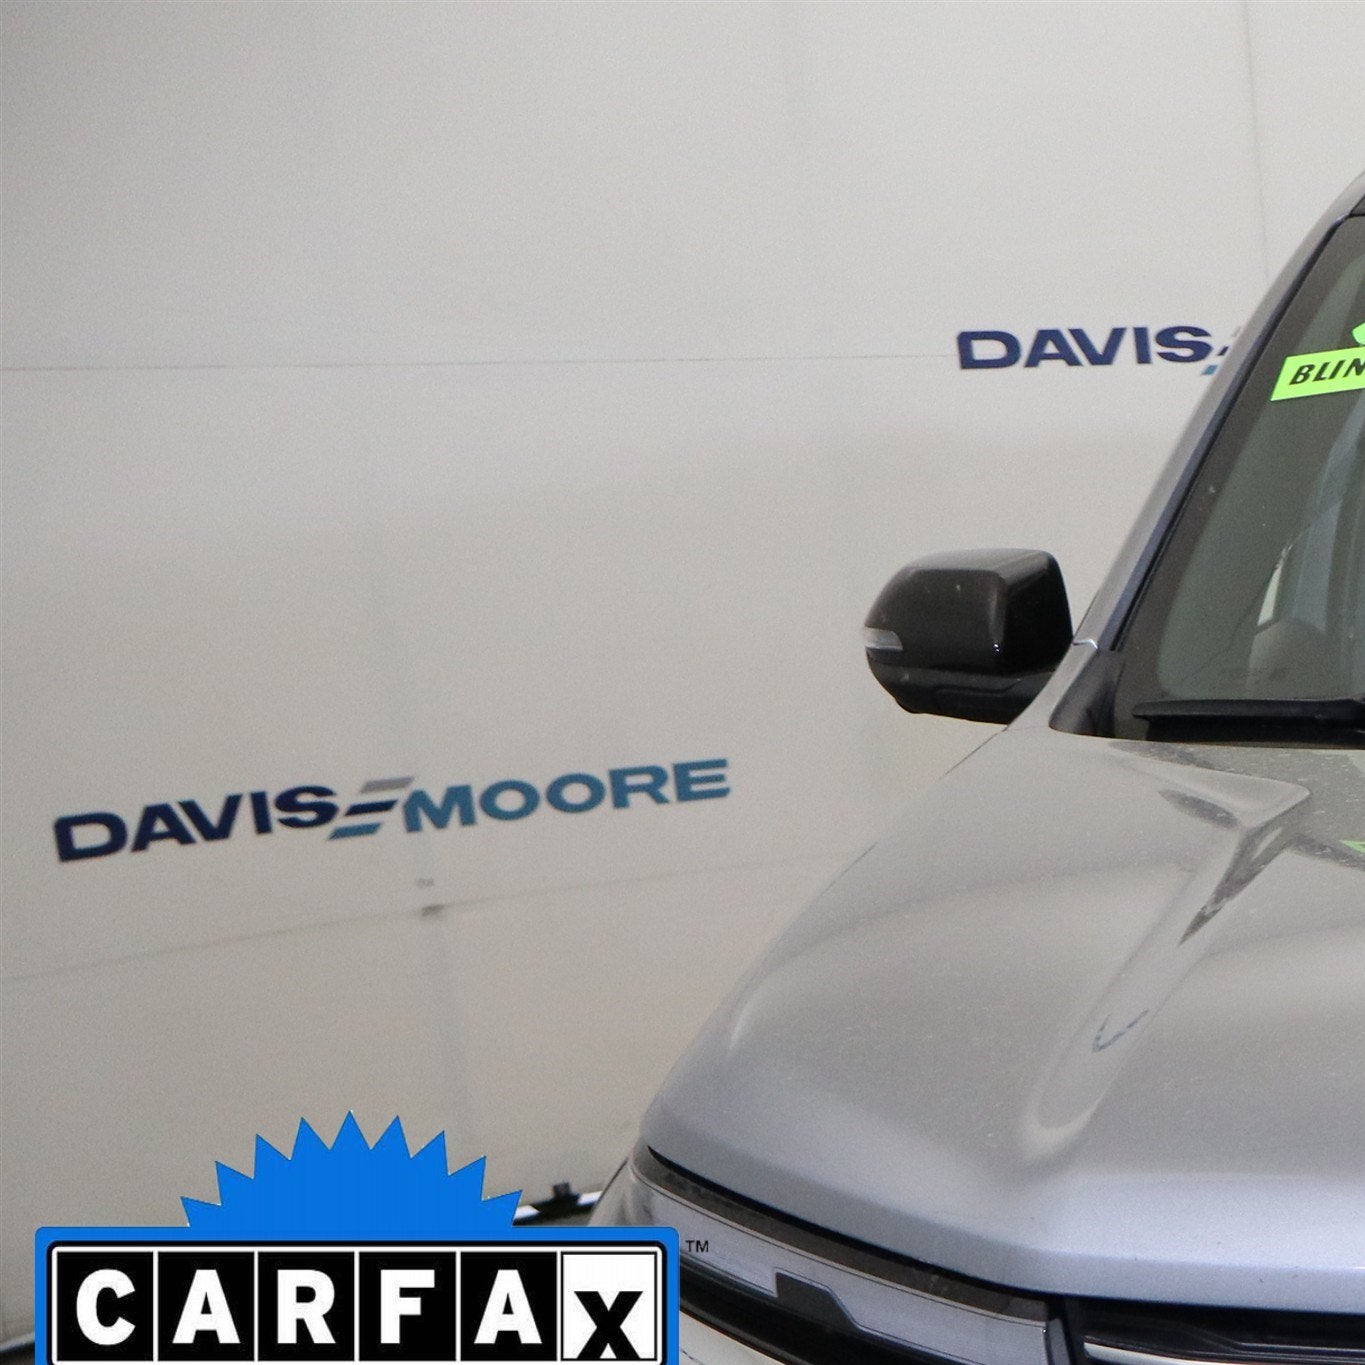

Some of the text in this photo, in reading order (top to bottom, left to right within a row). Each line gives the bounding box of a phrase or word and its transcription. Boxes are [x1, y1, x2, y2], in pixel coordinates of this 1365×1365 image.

[956, 325, 1214, 370] DAVIS
[53, 758, 731, 863] DAVIS MOORE
